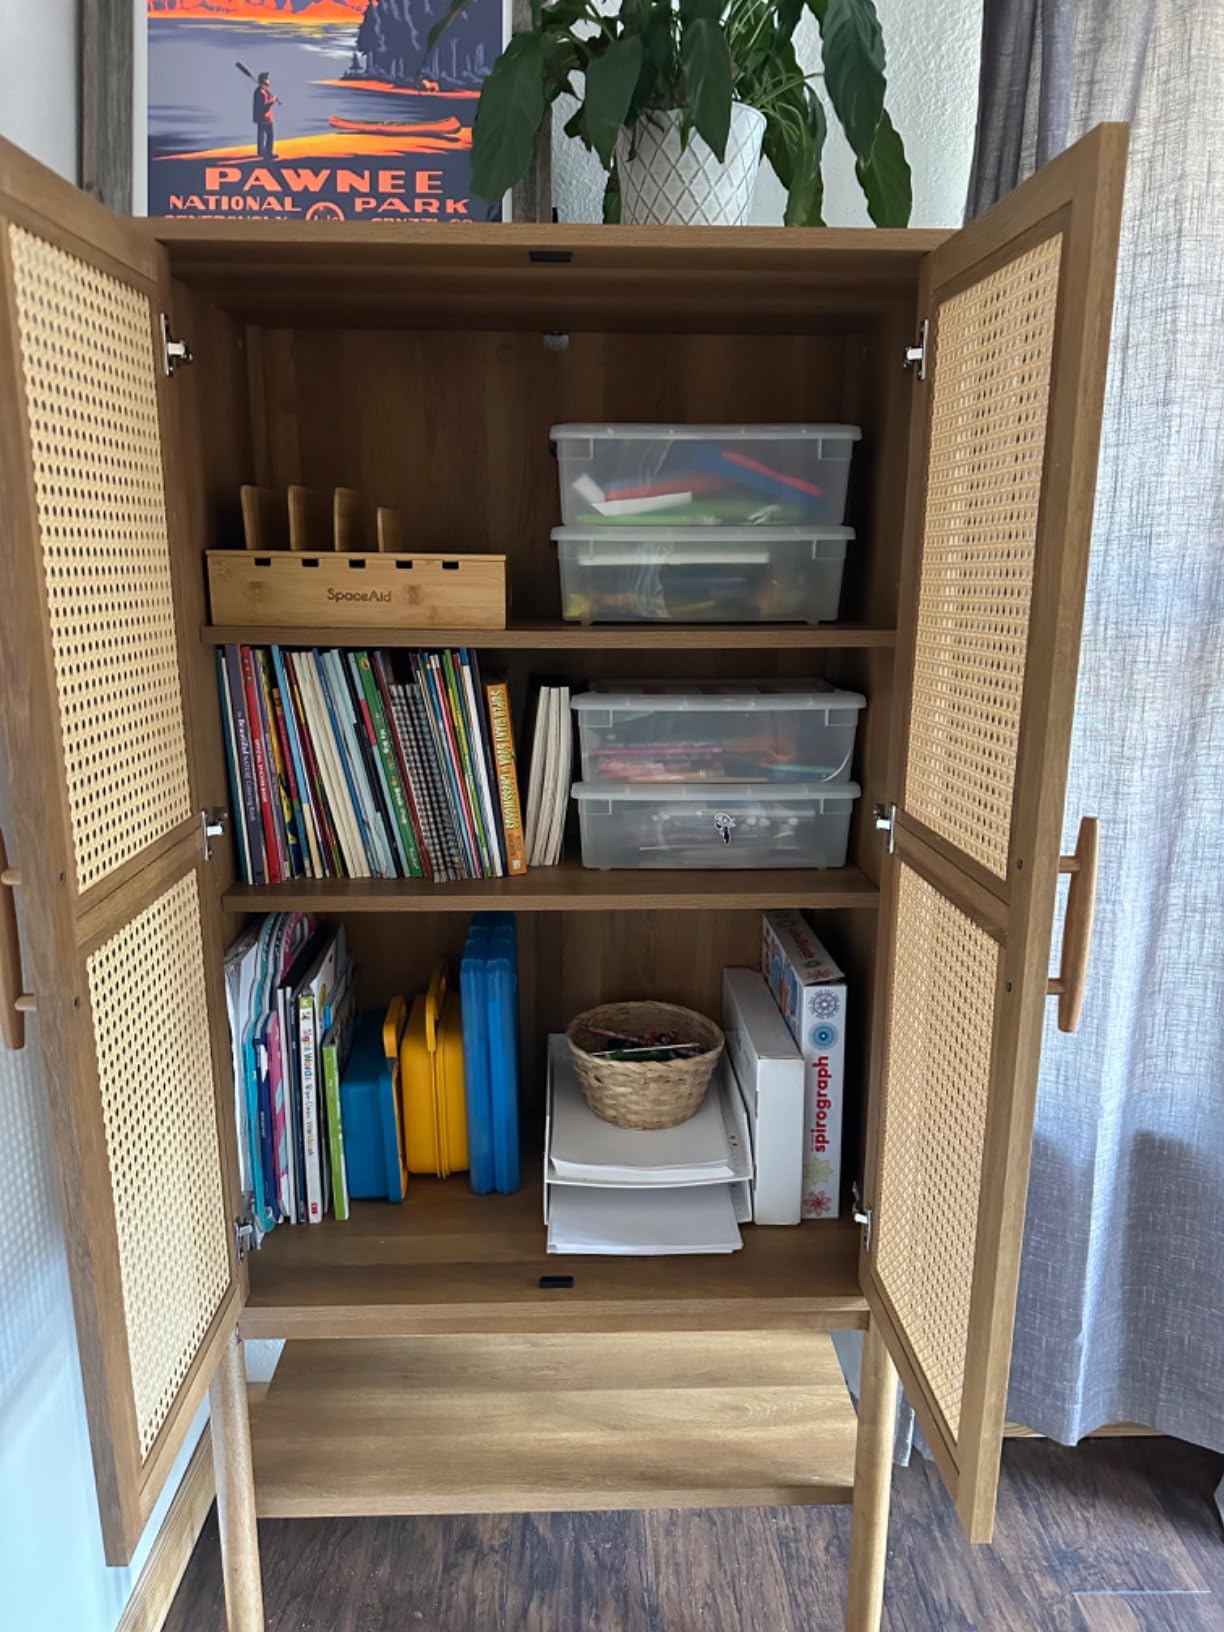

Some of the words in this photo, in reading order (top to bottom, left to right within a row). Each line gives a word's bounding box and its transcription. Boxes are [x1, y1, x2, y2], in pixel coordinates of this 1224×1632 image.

[204, 167, 444, 194] PAWNEE
[168, 194, 302, 212] NATIONAL
[354, 197, 472, 214] PARK
[327, 587, 392, 604] SpaceAid
[238, 718, 249, 755] Beautiful
[302, 1028, 312, 1052] Sight
[304, 1053, 313, 1081] Words
[812, 1055, 832, 1153] spirograph
